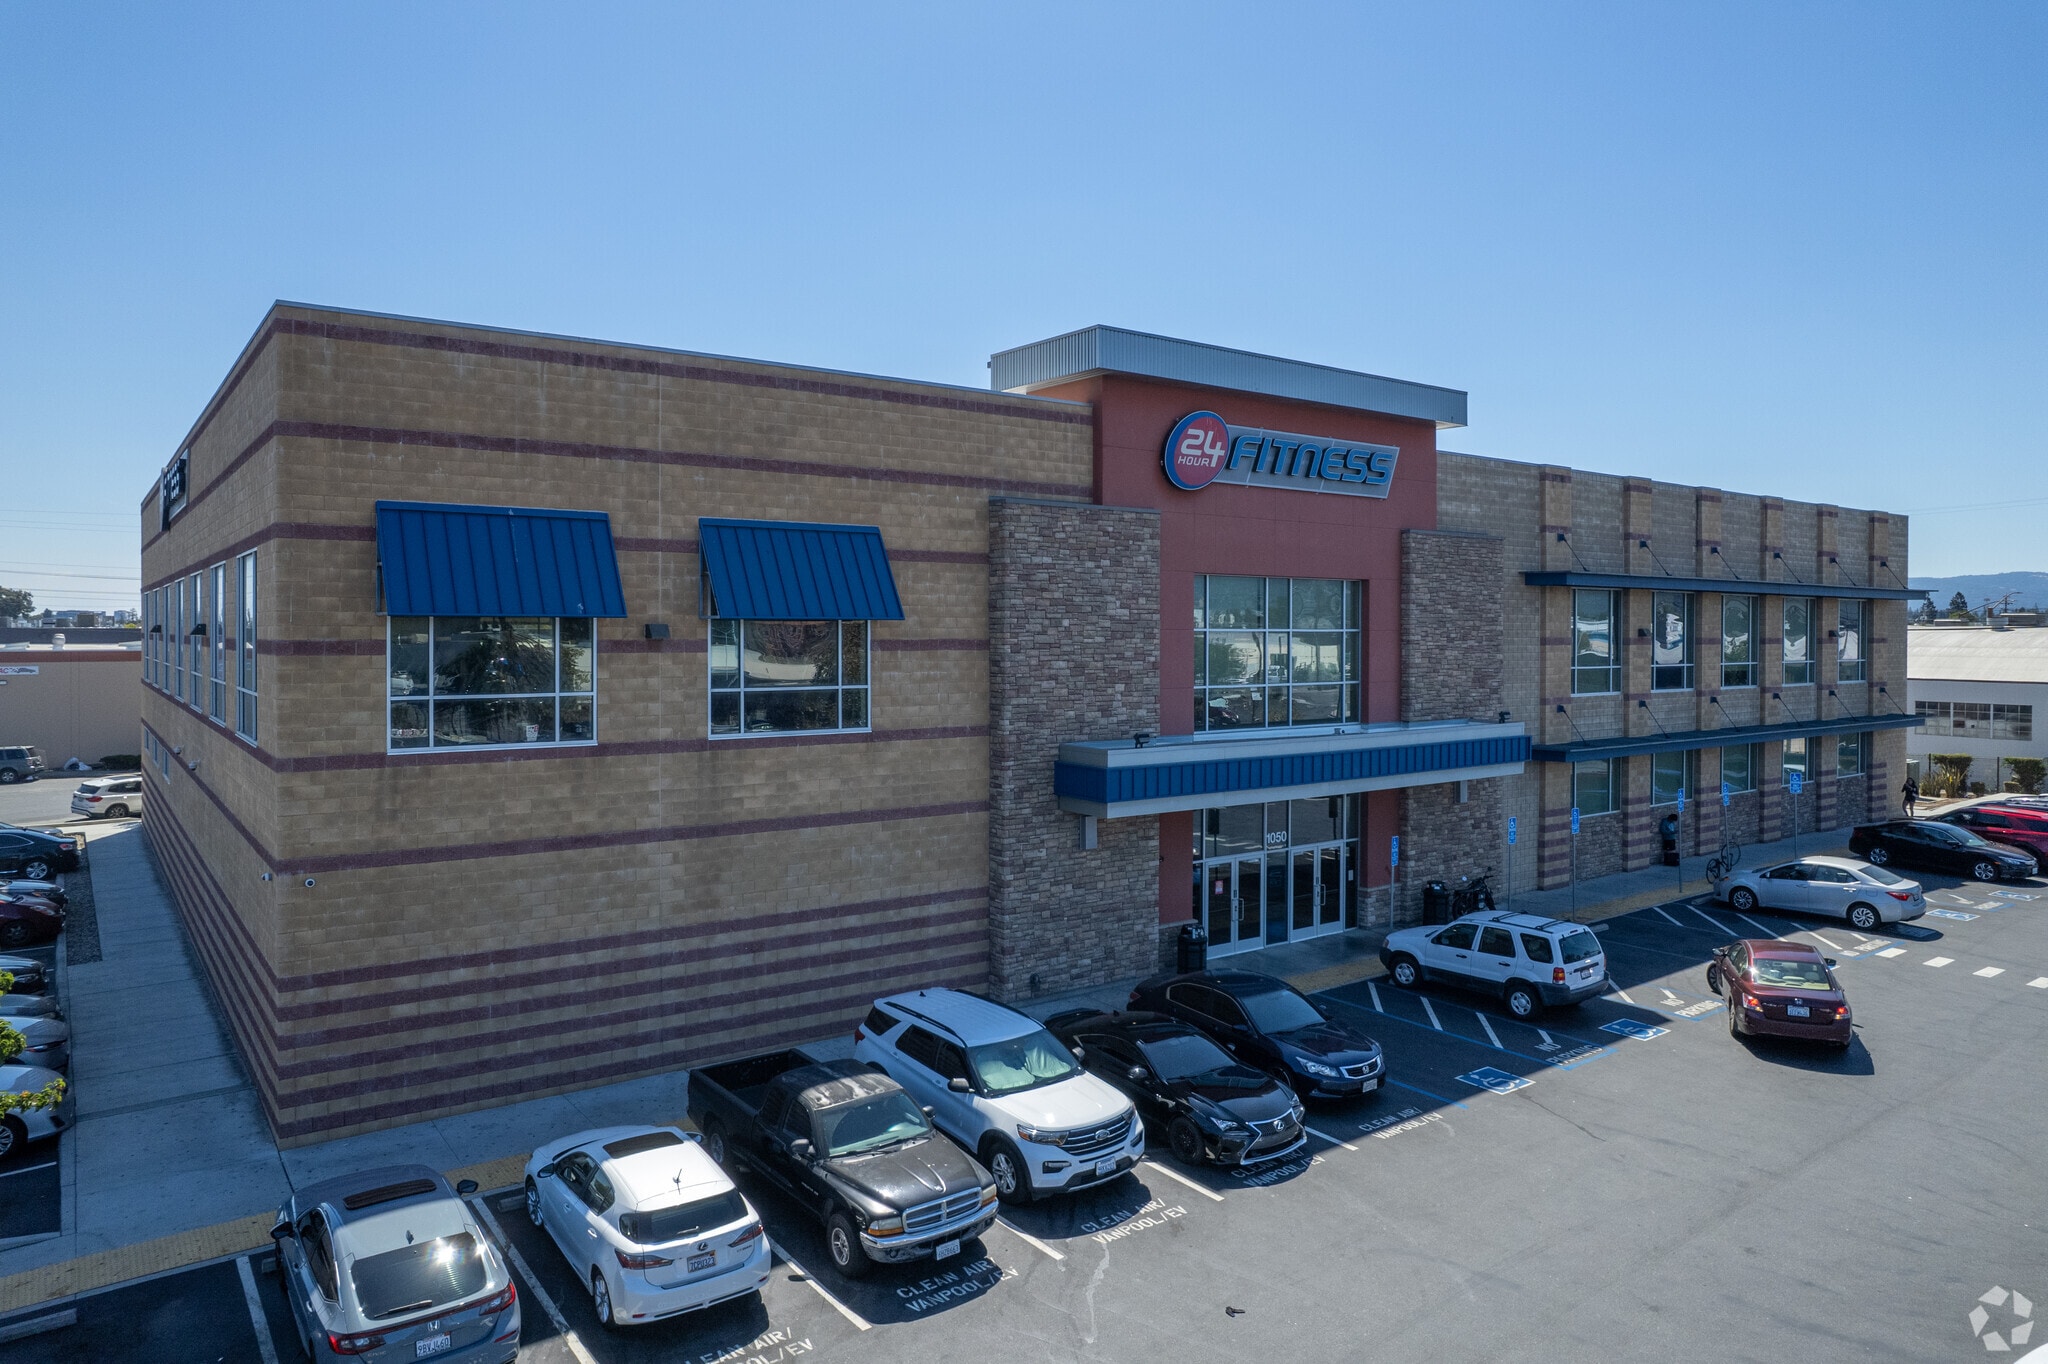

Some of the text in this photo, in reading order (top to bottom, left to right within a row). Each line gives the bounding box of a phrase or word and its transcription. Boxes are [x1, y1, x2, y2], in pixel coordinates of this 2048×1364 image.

[1180, 428, 1225, 468] 24
[1229, 435, 1394, 485] FITNESS
[1177, 455, 1210, 467] HOUR
[1266, 830, 1288, 844] 1050
[1534, 1042, 1562, 1053] NO
[1545, 1044, 1603, 1066] PARKING
[1358, 1115, 1400, 1132] CLEAN
[1371, 1111, 1444, 1140] VANPOOL/EV
[1230, 1160, 1277, 1178] CLEAN
[1081, 1197, 1166, 1234] CLEAN AIR/
[1091, 1205, 1188, 1244] VANPOOL/EV
[896, 1272, 960, 1300] CLEAN
[905, 1266, 1020, 1313] VANPOOL/EV
[417, 1337, 450, 1355] 9BVJ460
[753, 1326, 792, 1350] AIR/
